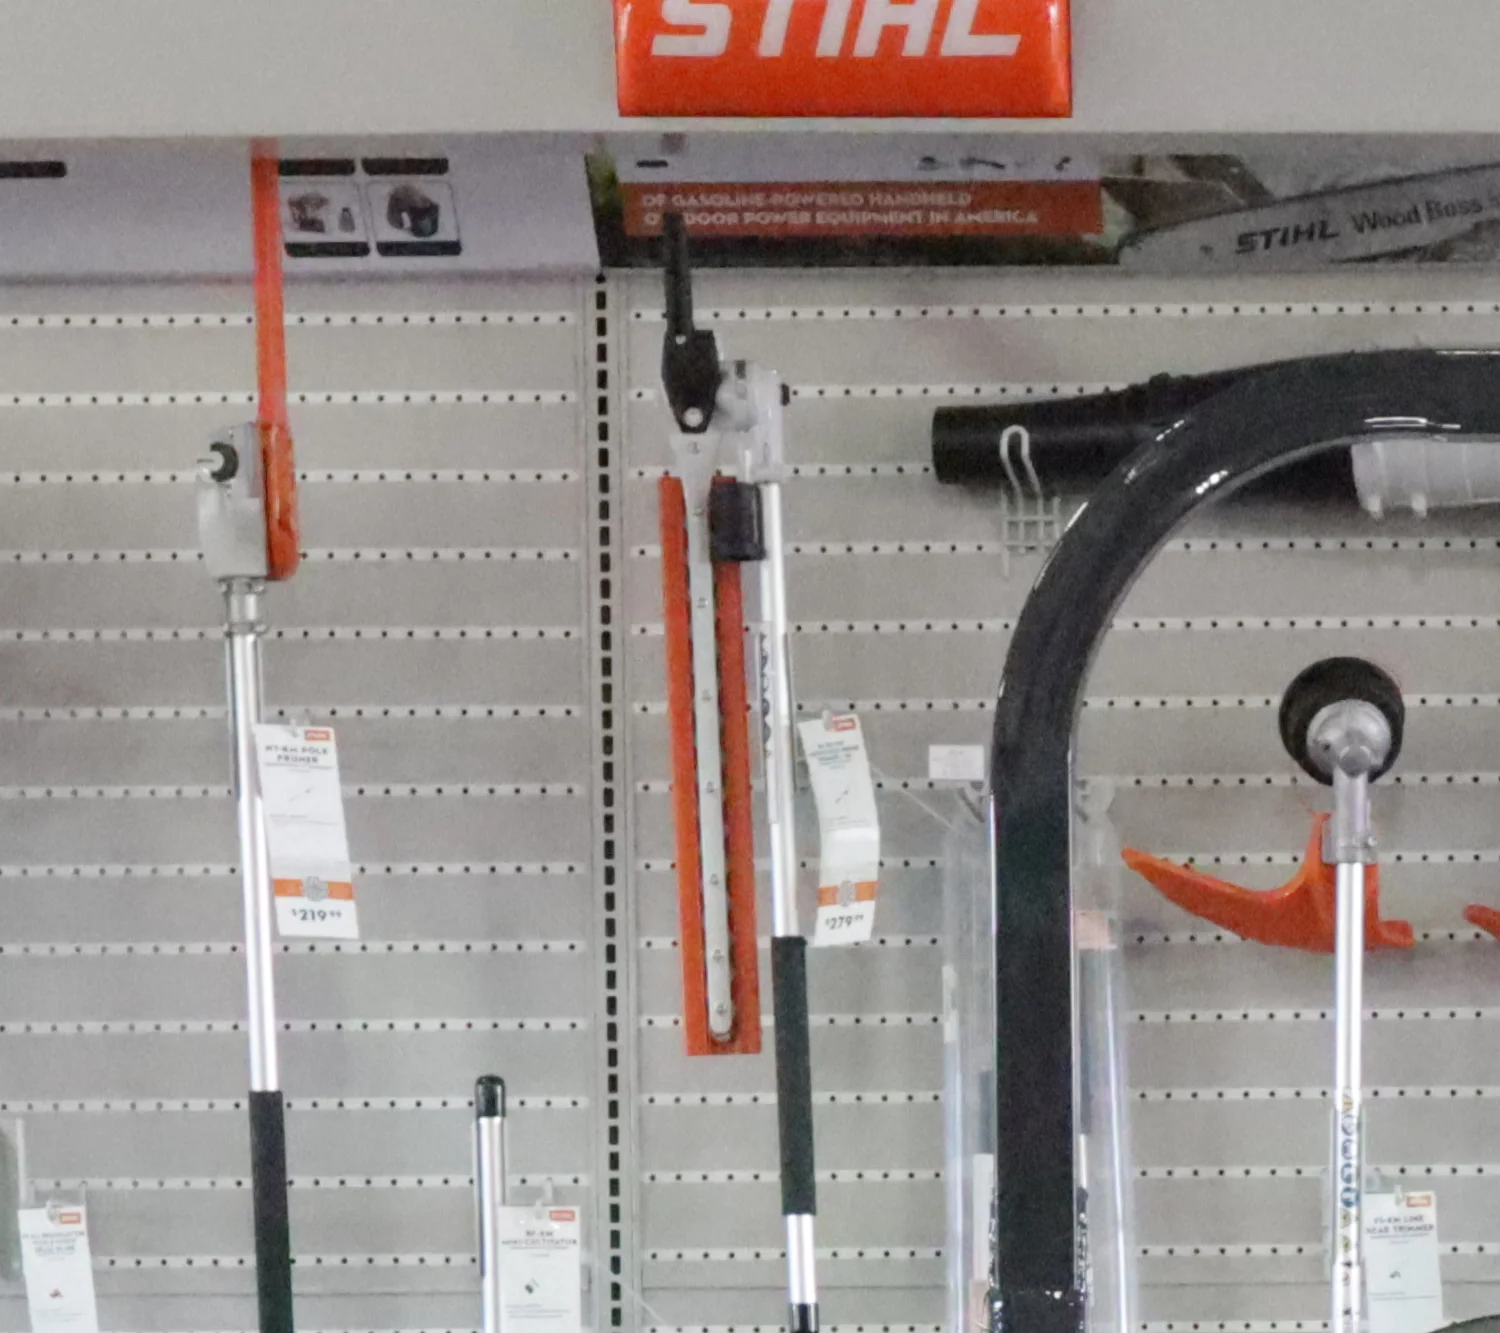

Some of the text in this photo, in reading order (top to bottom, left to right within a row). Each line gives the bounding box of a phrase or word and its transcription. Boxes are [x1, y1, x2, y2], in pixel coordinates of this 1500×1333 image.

[650, 0, 1022, 58] STIHL
[869, 190, 971, 206] HANDHELD
[643, 209, 1039, 226] ODOOR POWER EQUIPMENT IN AMERICA
[1236, 197, 1484, 255] STIHL Wood Boss
